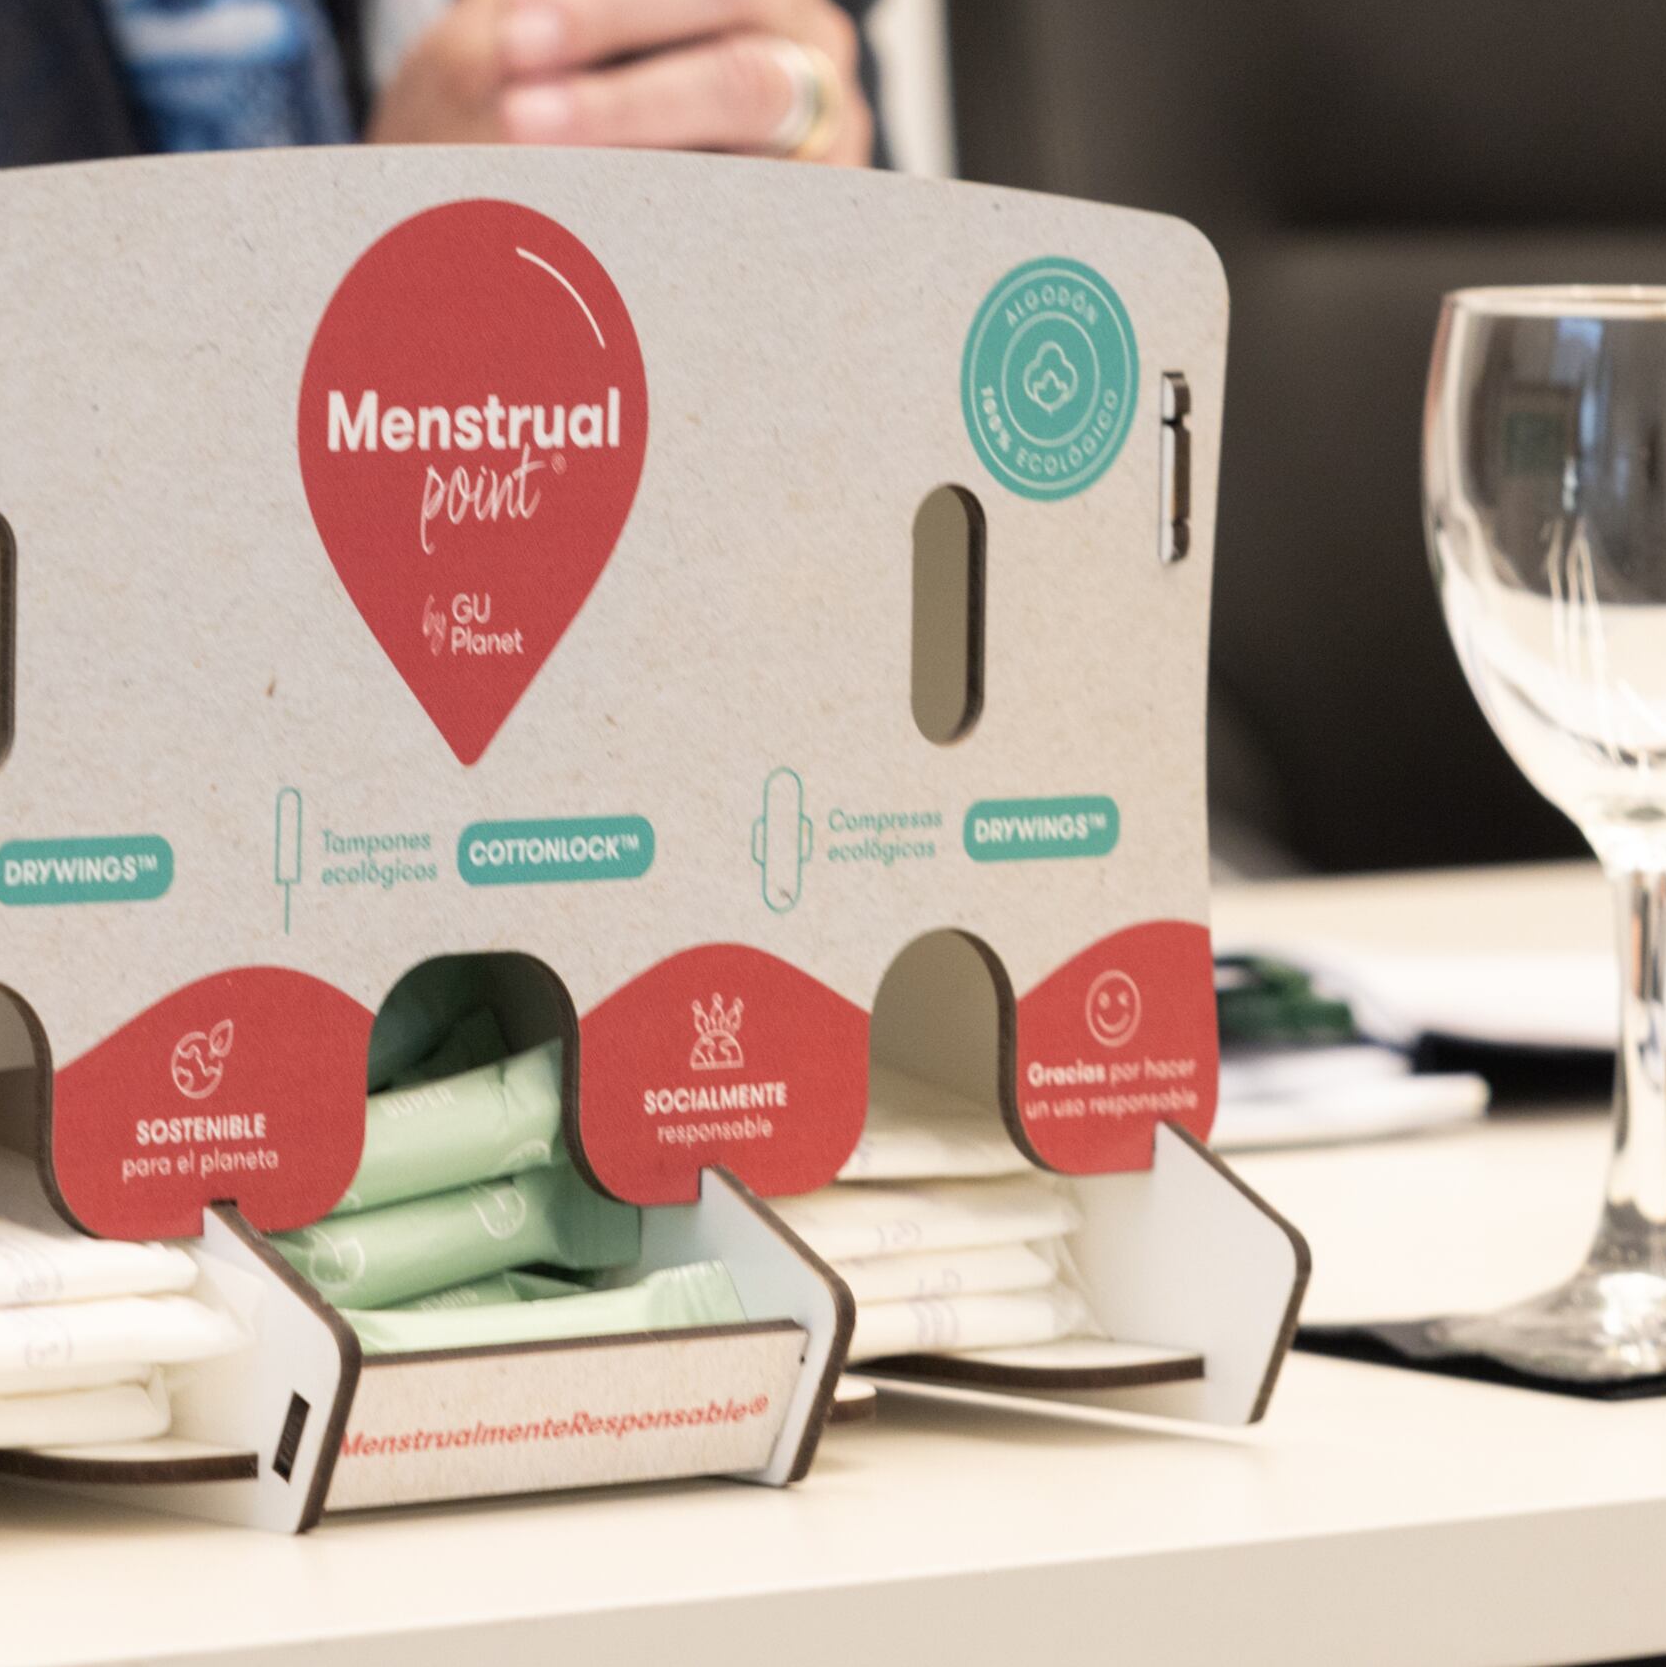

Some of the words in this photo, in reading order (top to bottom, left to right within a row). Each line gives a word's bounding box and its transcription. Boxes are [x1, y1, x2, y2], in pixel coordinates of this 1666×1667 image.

[327, 386, 621, 452] Menstrual
[451, 592, 491, 624] GU
[451, 626, 524, 656] Planet
[828, 808, 942, 834] Compresas
[322, 829, 431, 857] Tampones
[828, 838, 935, 867] ecológicas
[321, 858, 438, 891] ecológicos
[1027, 1058, 1106, 1087] Gracias
[1109, 1062, 1140, 1086] por
[1144, 1056, 1197, 1078] hacer
[644, 1082, 787, 1115] SOCIALMENTE
[1025, 1100, 1049, 1120] un
[1053, 1098, 1085, 1119] uso
[1089, 1087, 1198, 1120] responsable
[136, 1113, 266, 1145] SOSTENIBLE
[658, 1115, 774, 1148] responsable
[122, 1156, 172, 1184] para
[177, 1149, 195, 1175] el
[200, 1147, 279, 1179] planeta
